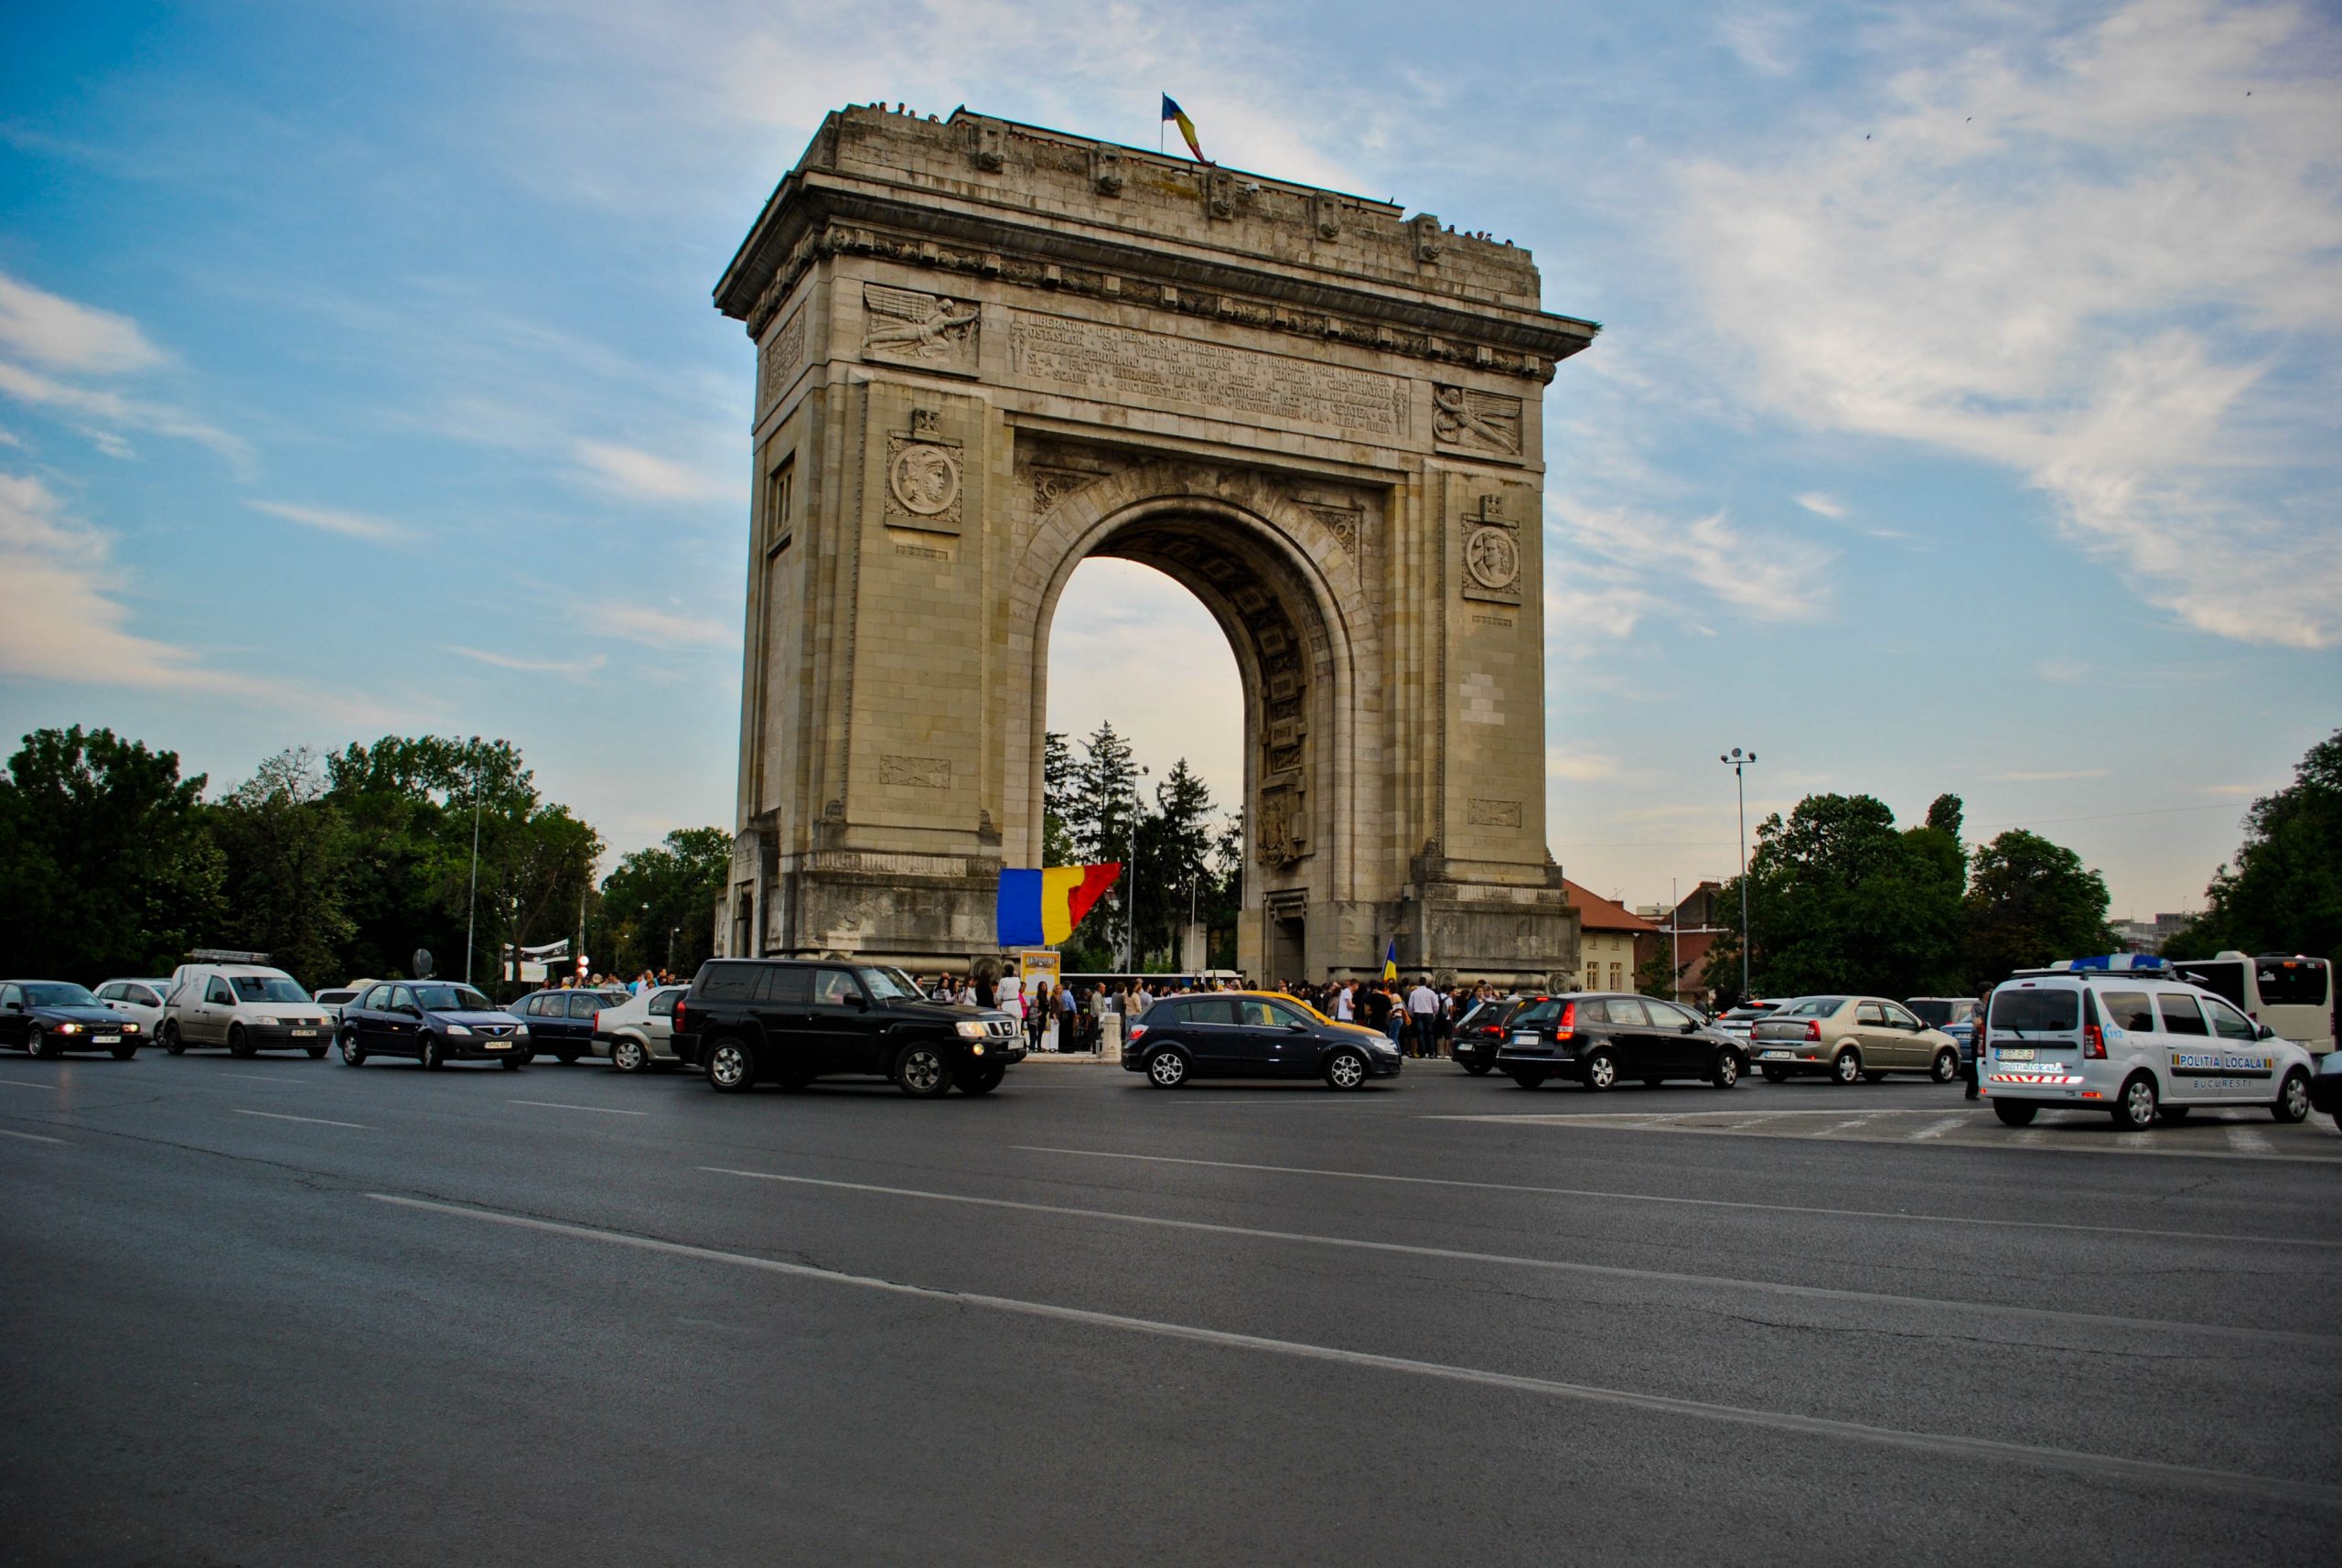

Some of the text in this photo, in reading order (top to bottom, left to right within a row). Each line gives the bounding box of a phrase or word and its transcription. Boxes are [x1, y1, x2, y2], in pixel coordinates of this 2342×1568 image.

[1028, 314, 1085, 334] LIBERATOR
[1098, 327, 1112, 338] DE
[1245, 351, 1258, 364] DE
[1268, 356, 1305, 372] HOTARE
[1315, 365, 1335, 378] PRIN
[1346, 369, 1391, 387] VIRTUTEA
[1081, 349, 1139, 368] FERDINAND
[1229, 373, 1254, 388] REGE
[1027, 365, 1042, 378] DE
[1310, 412, 1323, 424] LA
[1175, 376, 1187, 390] LA
[1219, 384, 1272, 403] OCTOMBRIE
[1281, 394, 1301, 408] 1922
[1273, 368, 1311, 386] EROILOR
